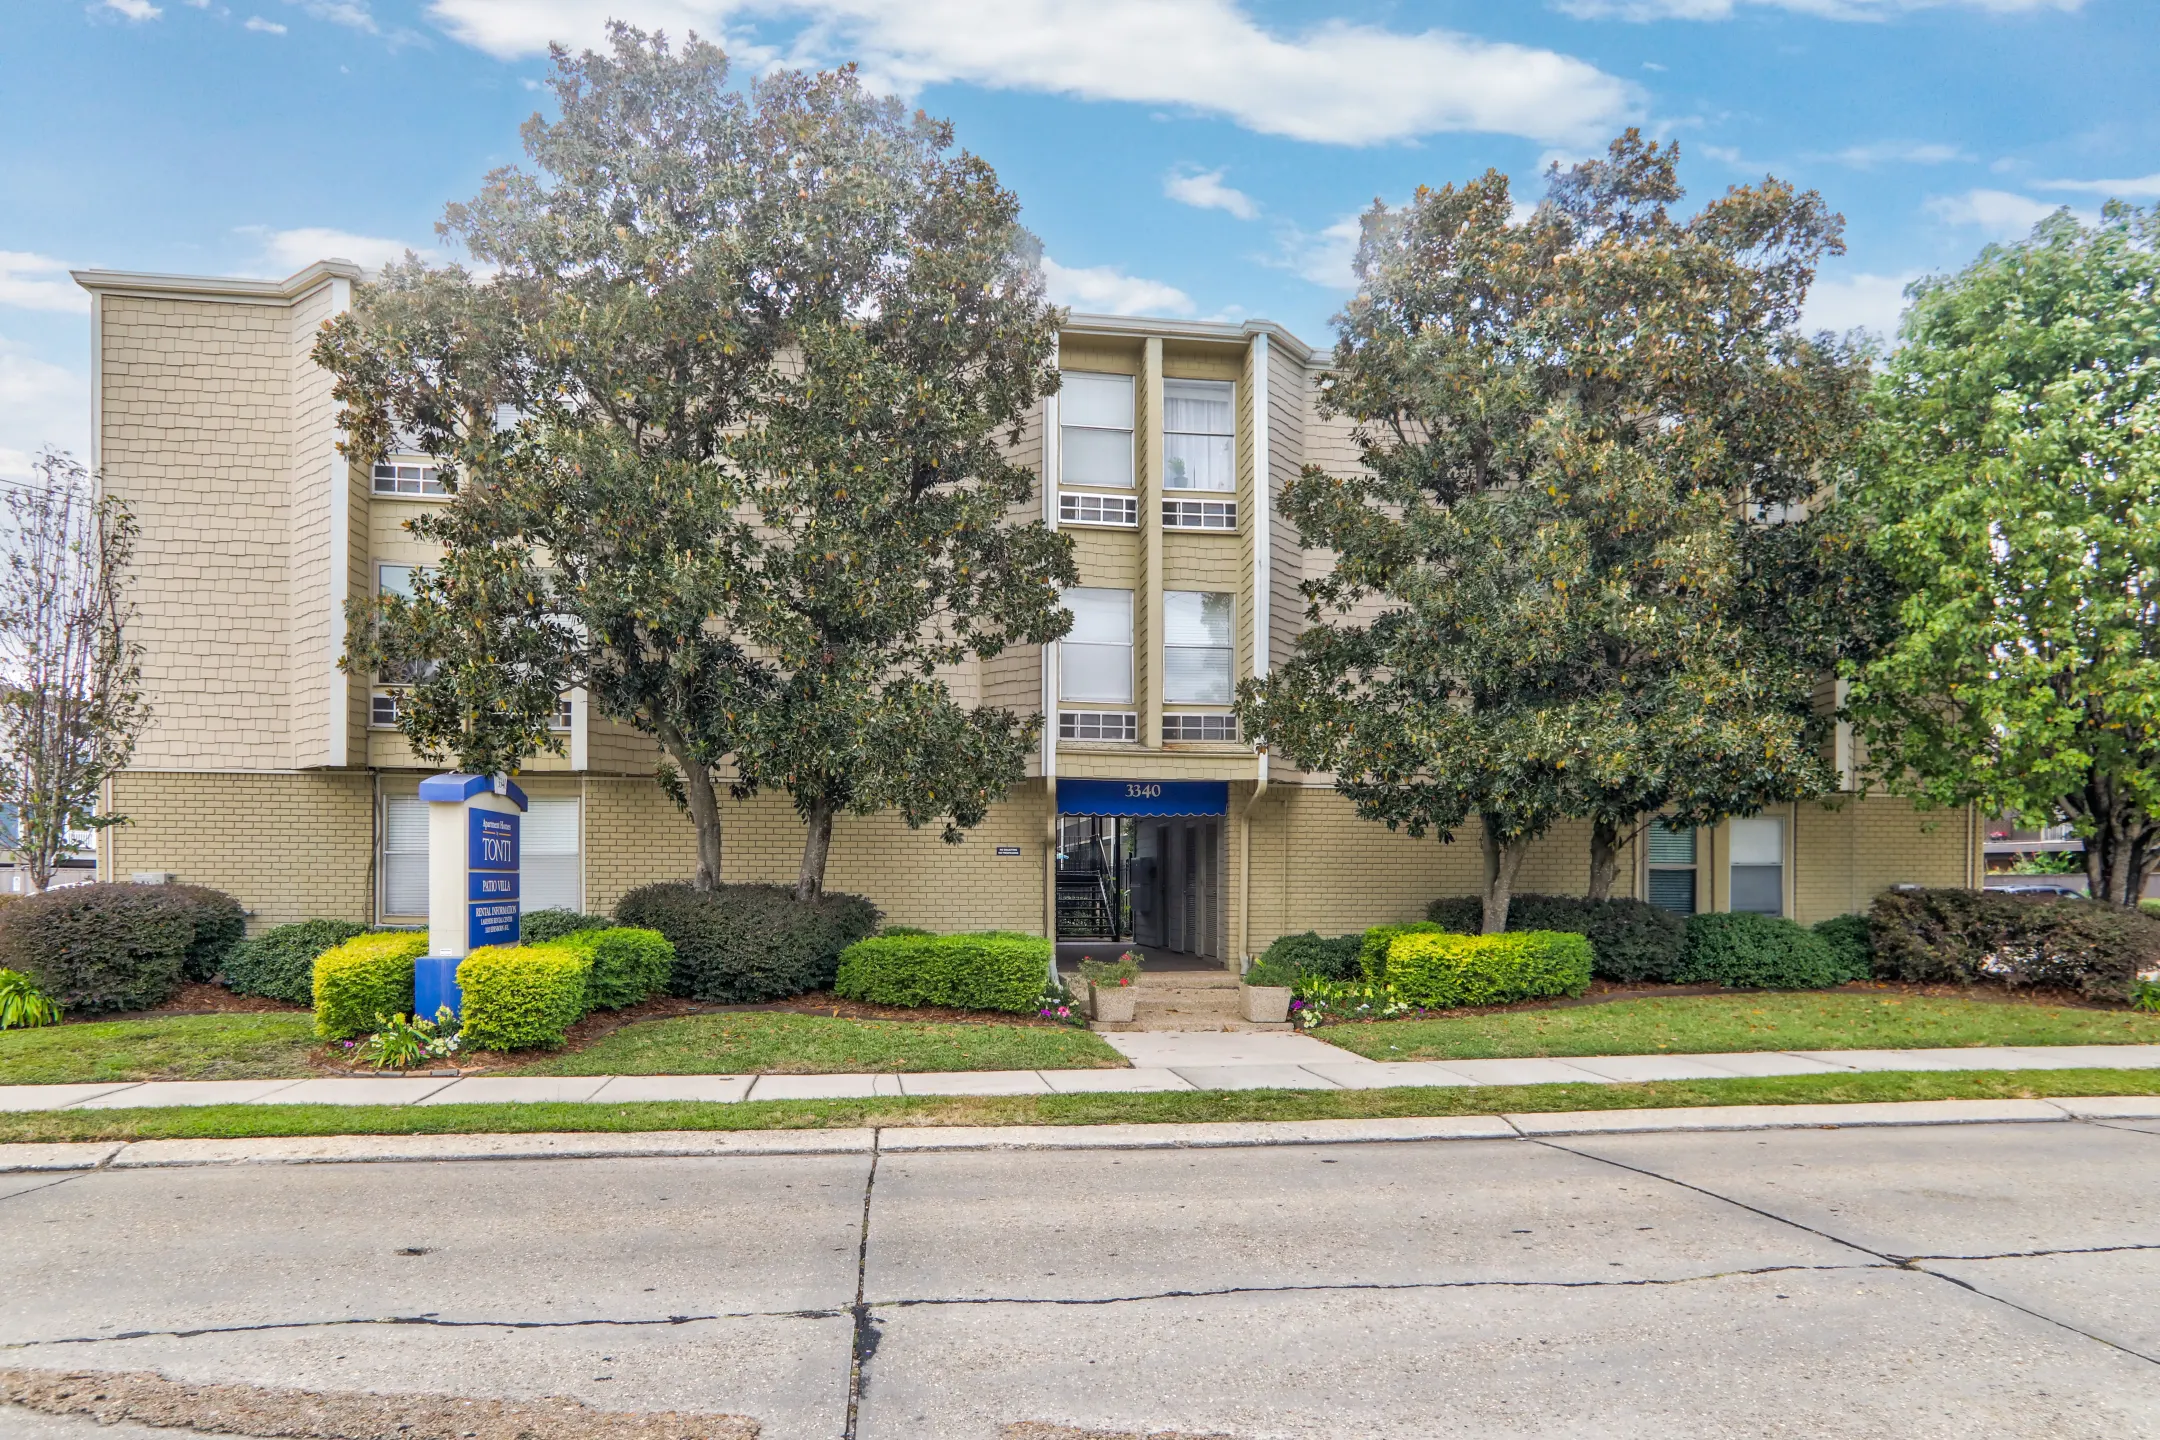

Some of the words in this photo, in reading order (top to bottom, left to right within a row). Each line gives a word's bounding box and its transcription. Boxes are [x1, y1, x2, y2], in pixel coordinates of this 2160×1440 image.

[1125, 784, 1161, 798] 3340
[483, 819, 499, 830] Apartment
[500, 821, 511, 830] Homes
[482, 838, 511, 861] TONTI
[483, 880, 497, 892] PATIO
[498, 880, 511, 891] VILLA
[476, 907, 491, 917] RENTAL
[492, 905, 516, 915] INFORMATION
